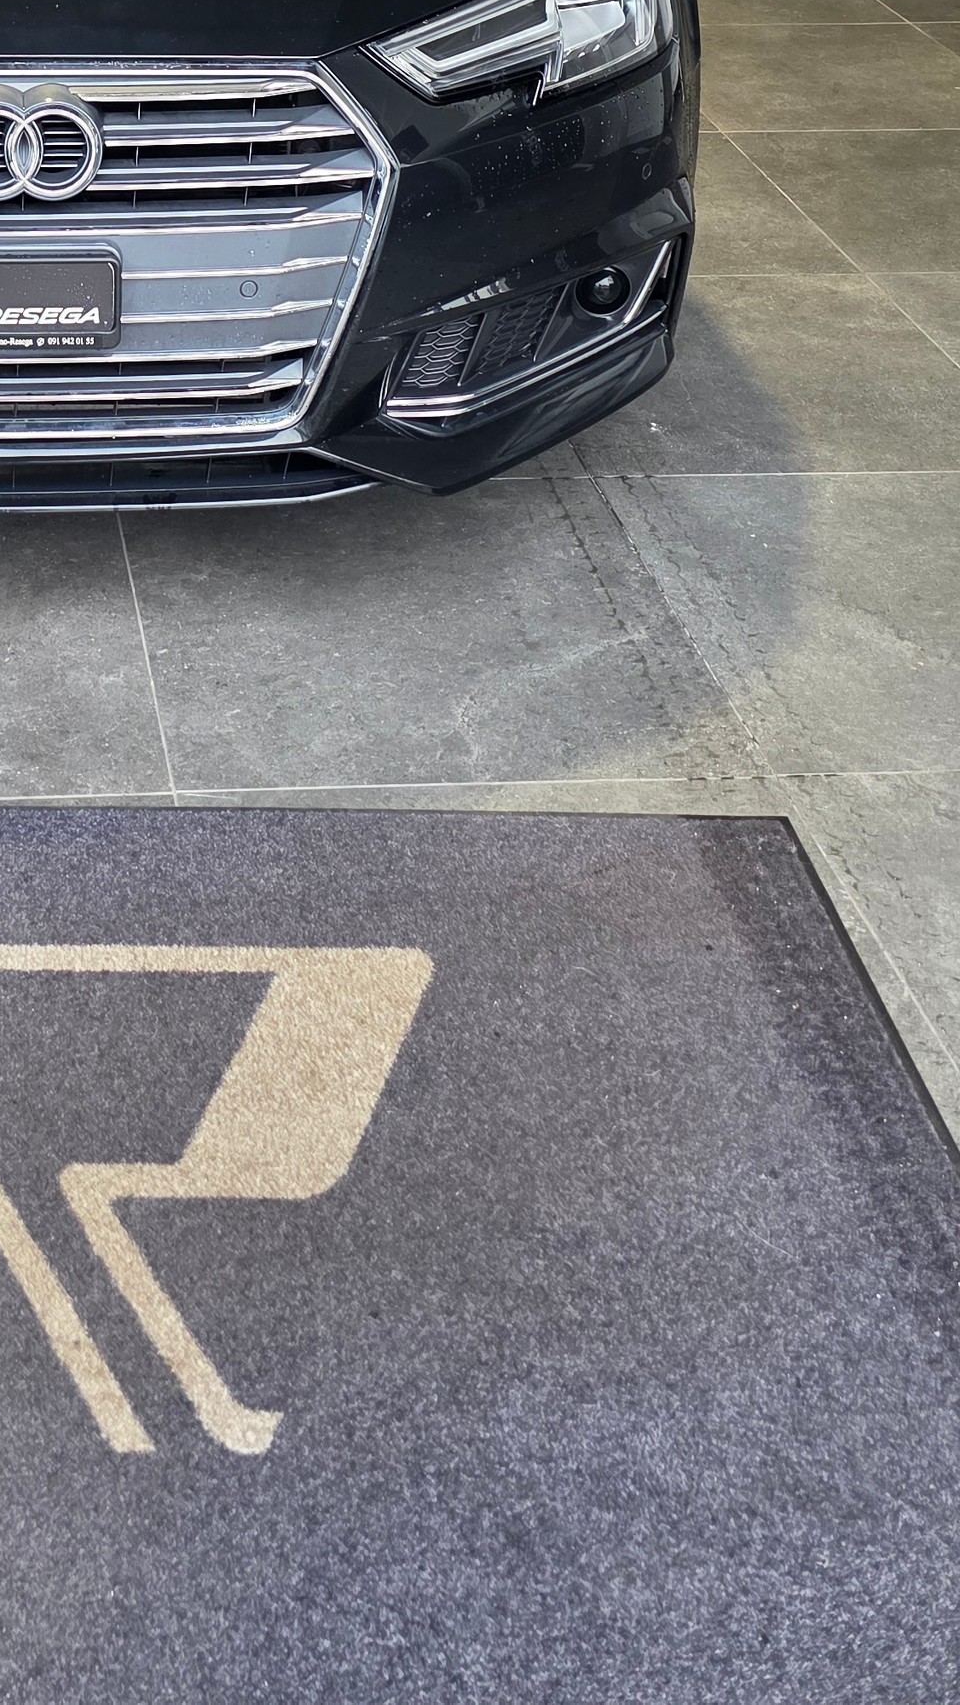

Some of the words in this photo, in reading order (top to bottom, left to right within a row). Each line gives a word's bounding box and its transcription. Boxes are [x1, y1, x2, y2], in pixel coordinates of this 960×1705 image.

[47, 337, 60, 346] 091
[61, 337, 74, 346] 942
[75, 337, 84, 345] 01
